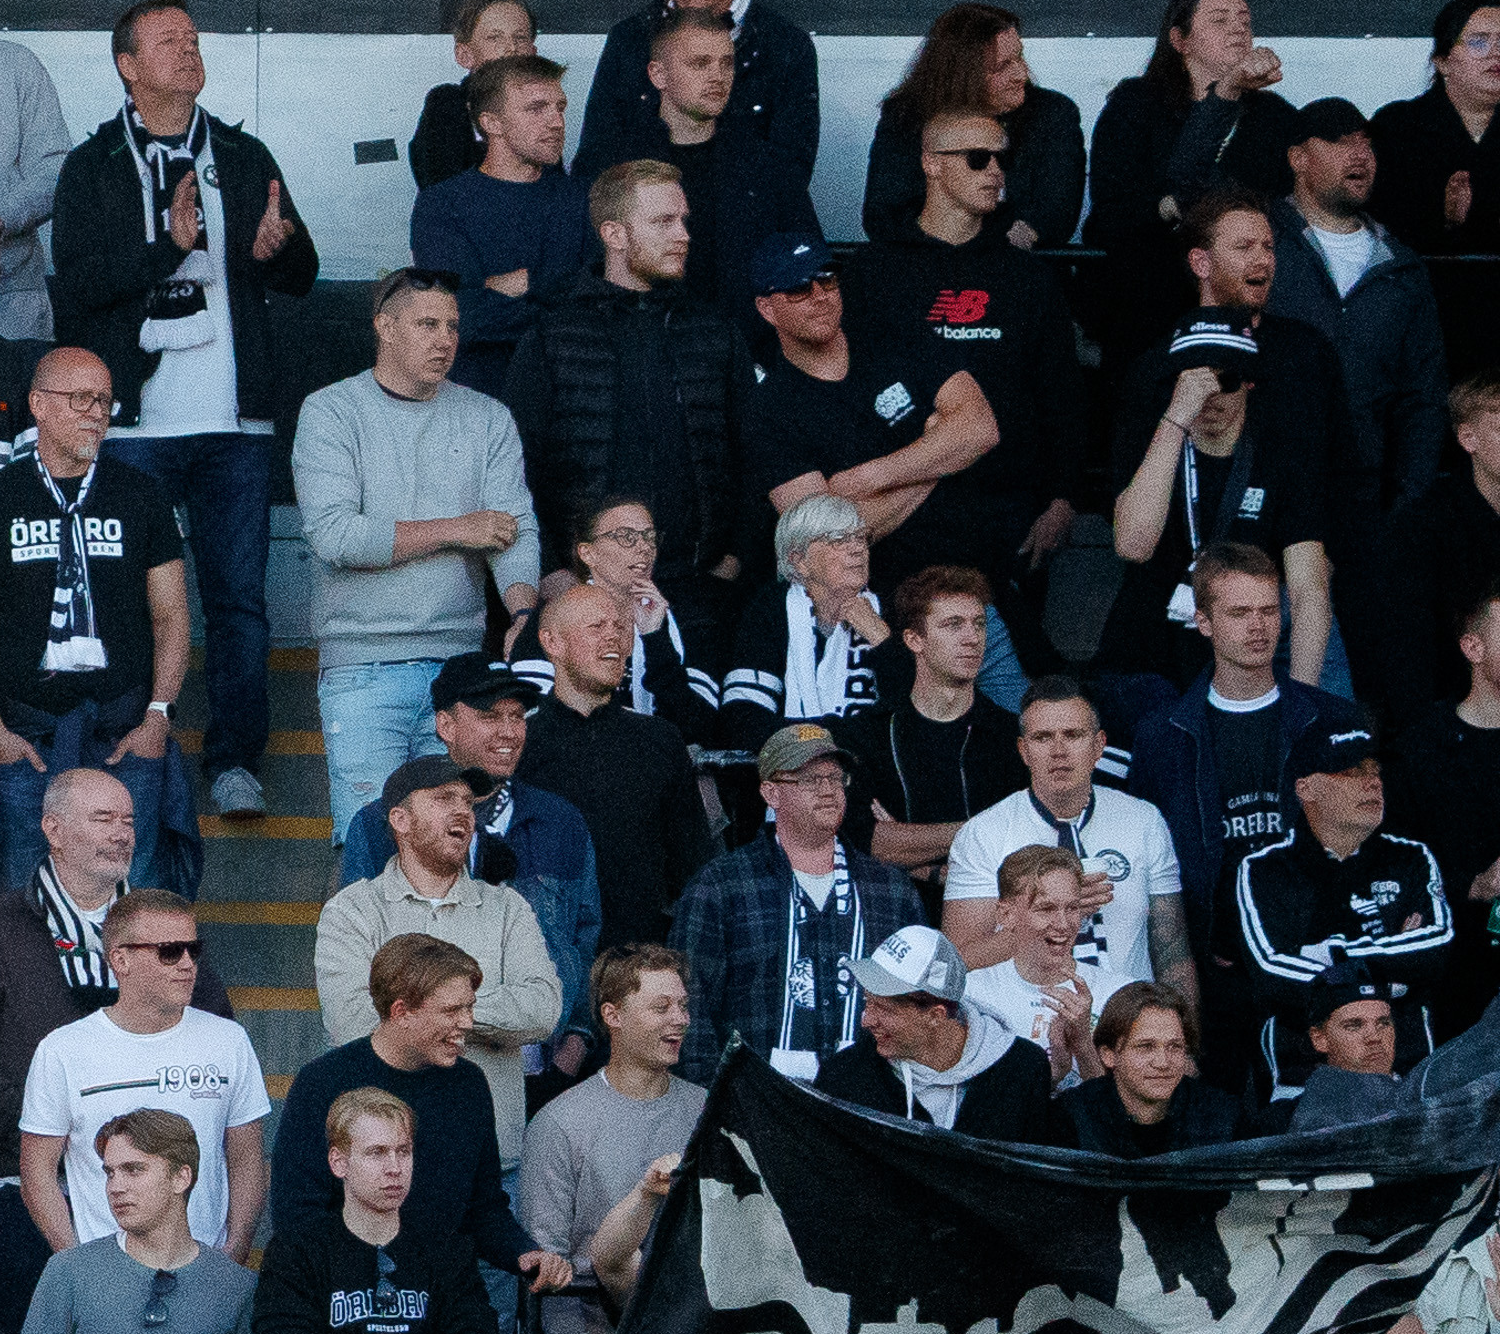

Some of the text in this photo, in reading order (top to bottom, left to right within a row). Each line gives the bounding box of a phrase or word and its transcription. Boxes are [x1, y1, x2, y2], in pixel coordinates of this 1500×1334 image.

[944, 326, 1002, 340] balance
[1190, 321, 1231, 332] ellesse
[11, 518, 123, 547] ÖRERO
[18, 544, 117, 558] SPORTBEN
[156, 1065, 222, 1094] 1908
